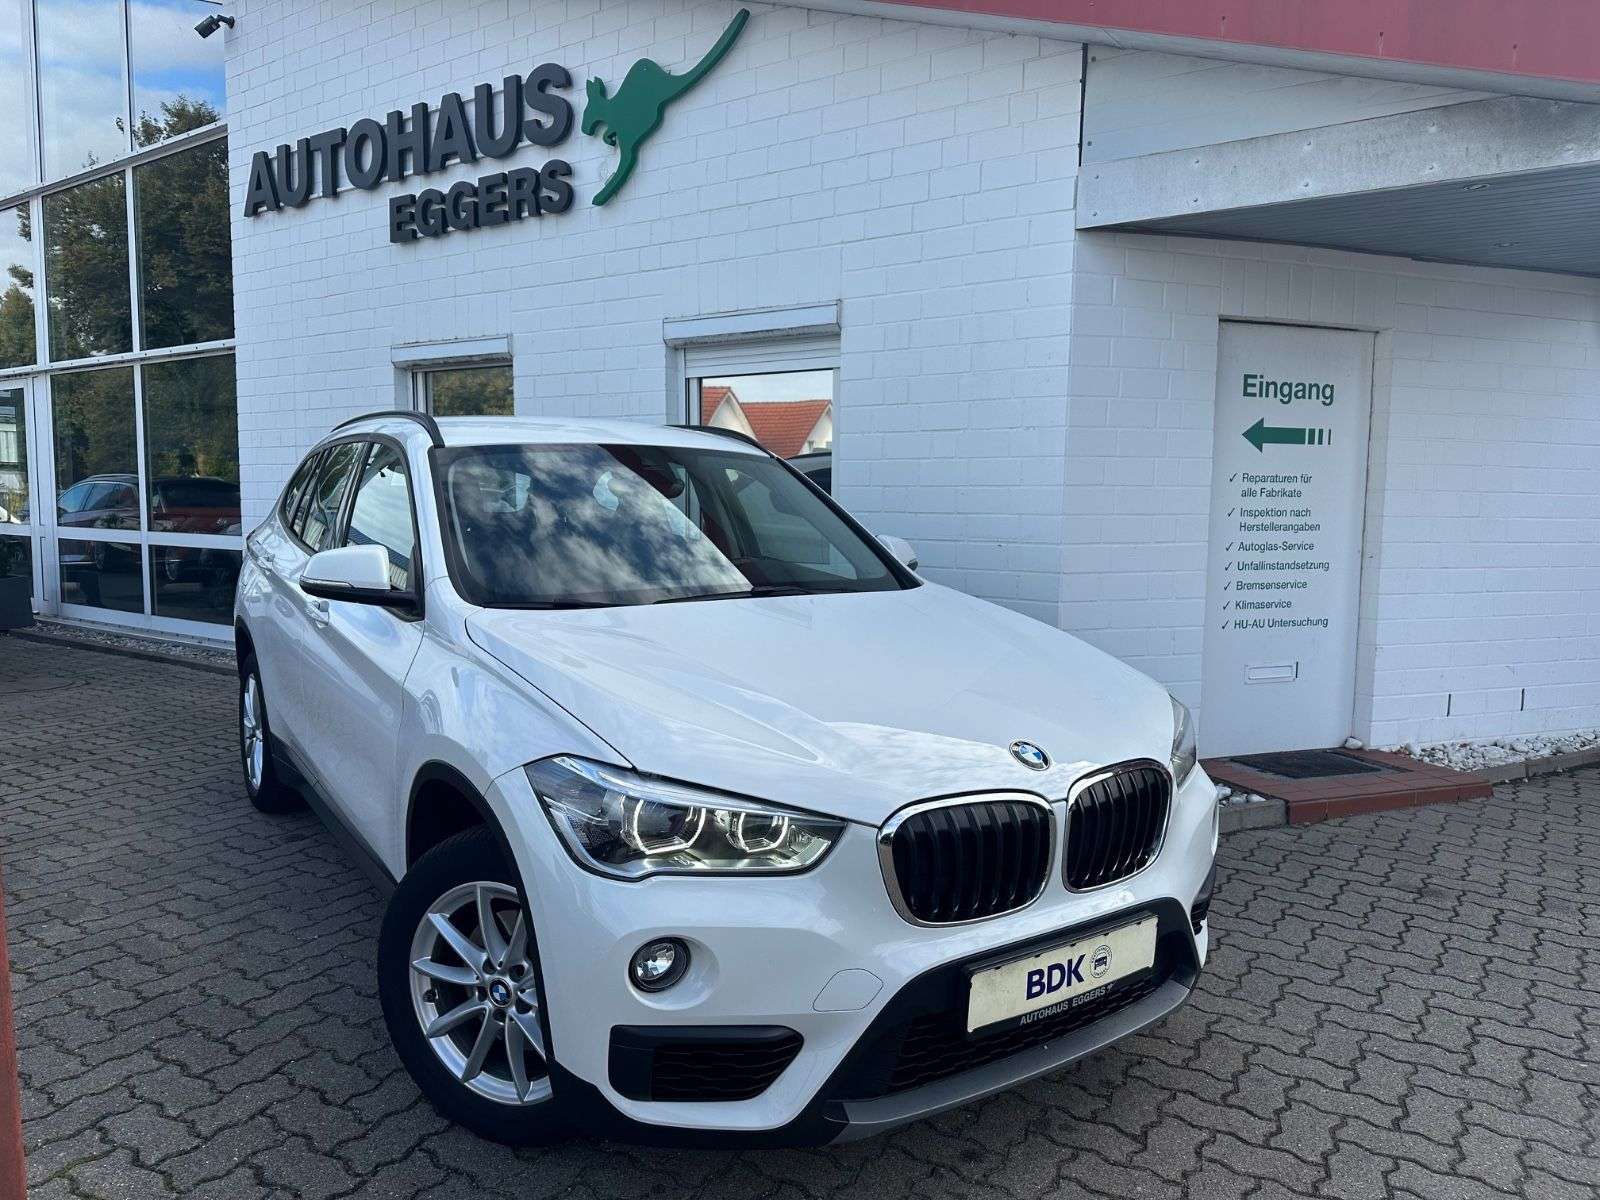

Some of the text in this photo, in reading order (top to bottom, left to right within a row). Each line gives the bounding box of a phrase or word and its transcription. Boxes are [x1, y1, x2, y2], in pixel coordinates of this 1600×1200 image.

[244, 62, 574, 218] AUTOHAUS
[389, 159, 574, 244] EGGERS
[1242, 373, 1335, 407] Eingang
[1242, 473, 1313, 484] Reparaturen für
[1241, 488, 1302, 498] alle Fabrikate
[1240, 507, 1311, 518] Inspektion nach
[1239, 522, 1321, 533] Herstellerangaben
[1238, 541, 1315, 553] Autoglas-Service
[1237, 560, 1330, 571] Unfallinstandsetzung
[1236, 580, 1308, 591] Bremsenservice
[1235, 600, 1292, 610] Klimaservice
[1234, 617, 1329, 629] HU-AU Untersuchung
[1026, 953, 1086, 1000] BDK
[1019, 986, 1106, 1026] AUTOHAUS EGGERS
